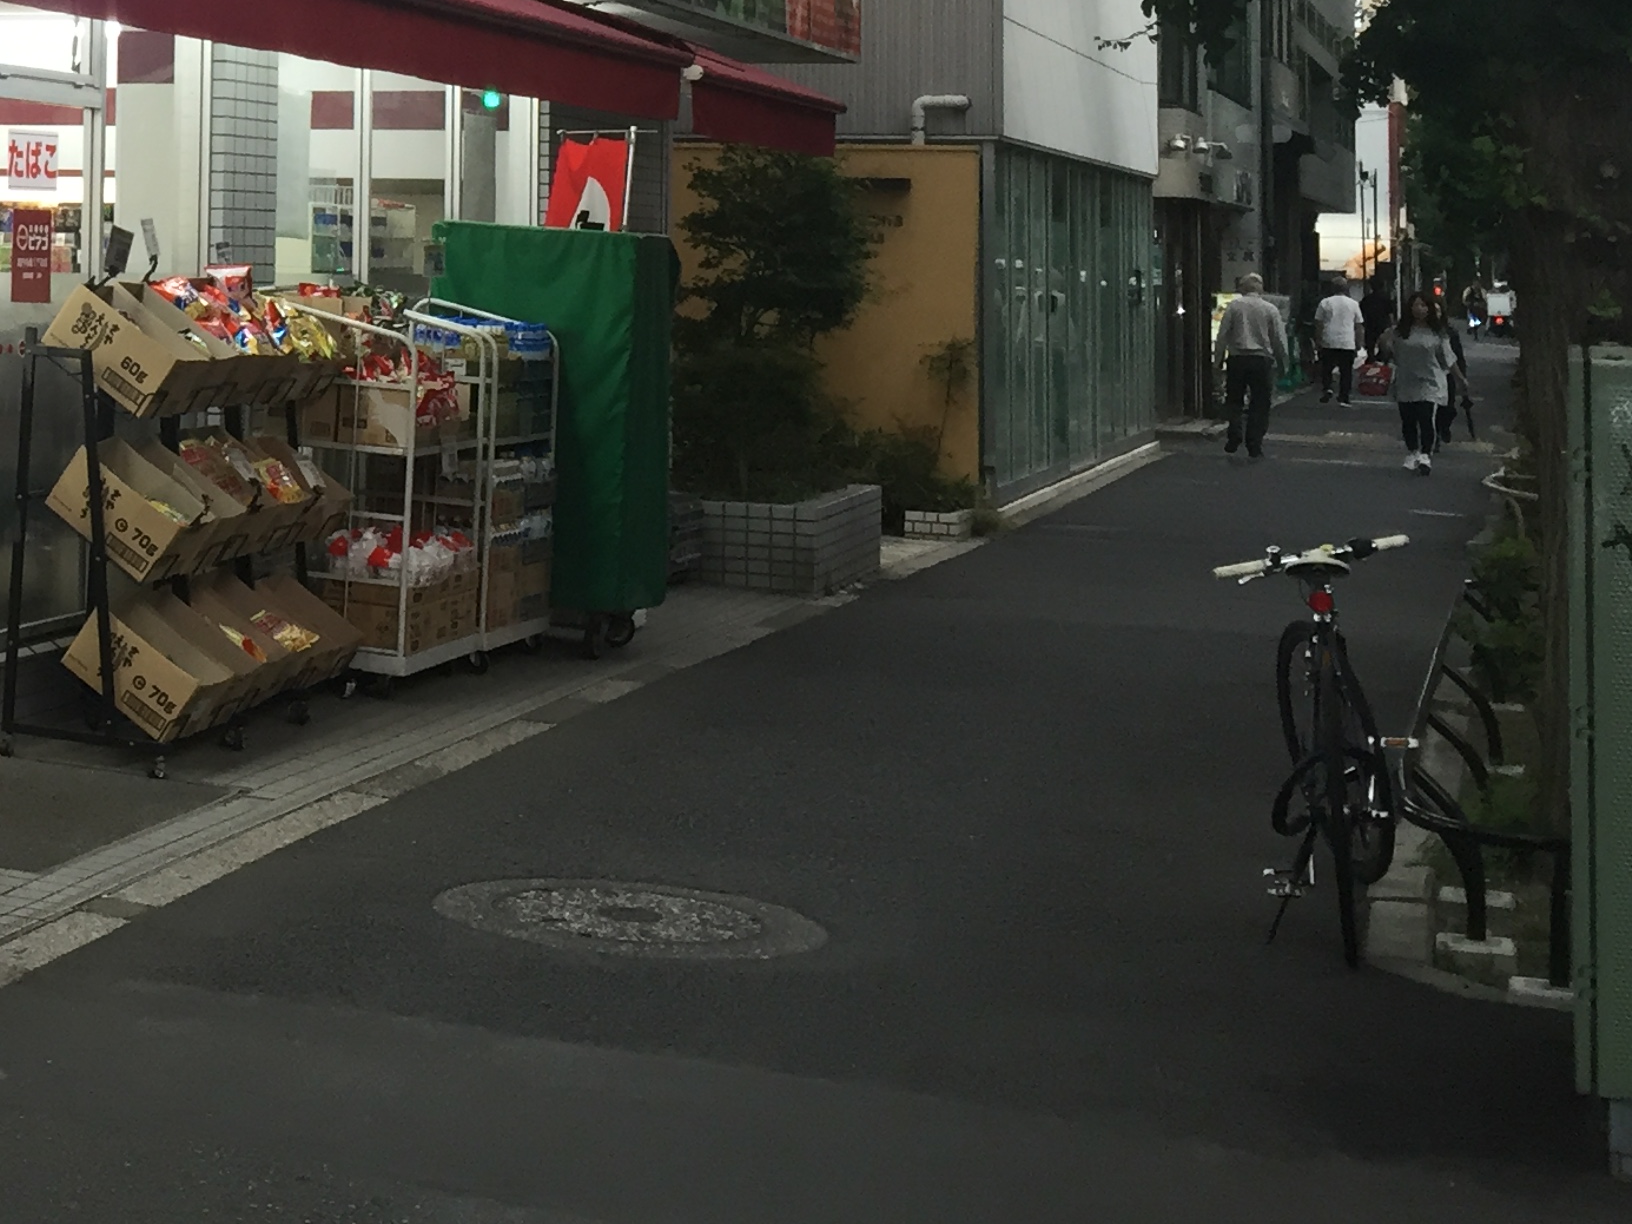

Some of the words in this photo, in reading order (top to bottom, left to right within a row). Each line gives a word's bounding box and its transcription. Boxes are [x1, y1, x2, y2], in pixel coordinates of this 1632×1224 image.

[8, 138, 58, 180] たばこ
[120, 356, 149, 384] 60g
[148, 684, 177, 715] 70g
